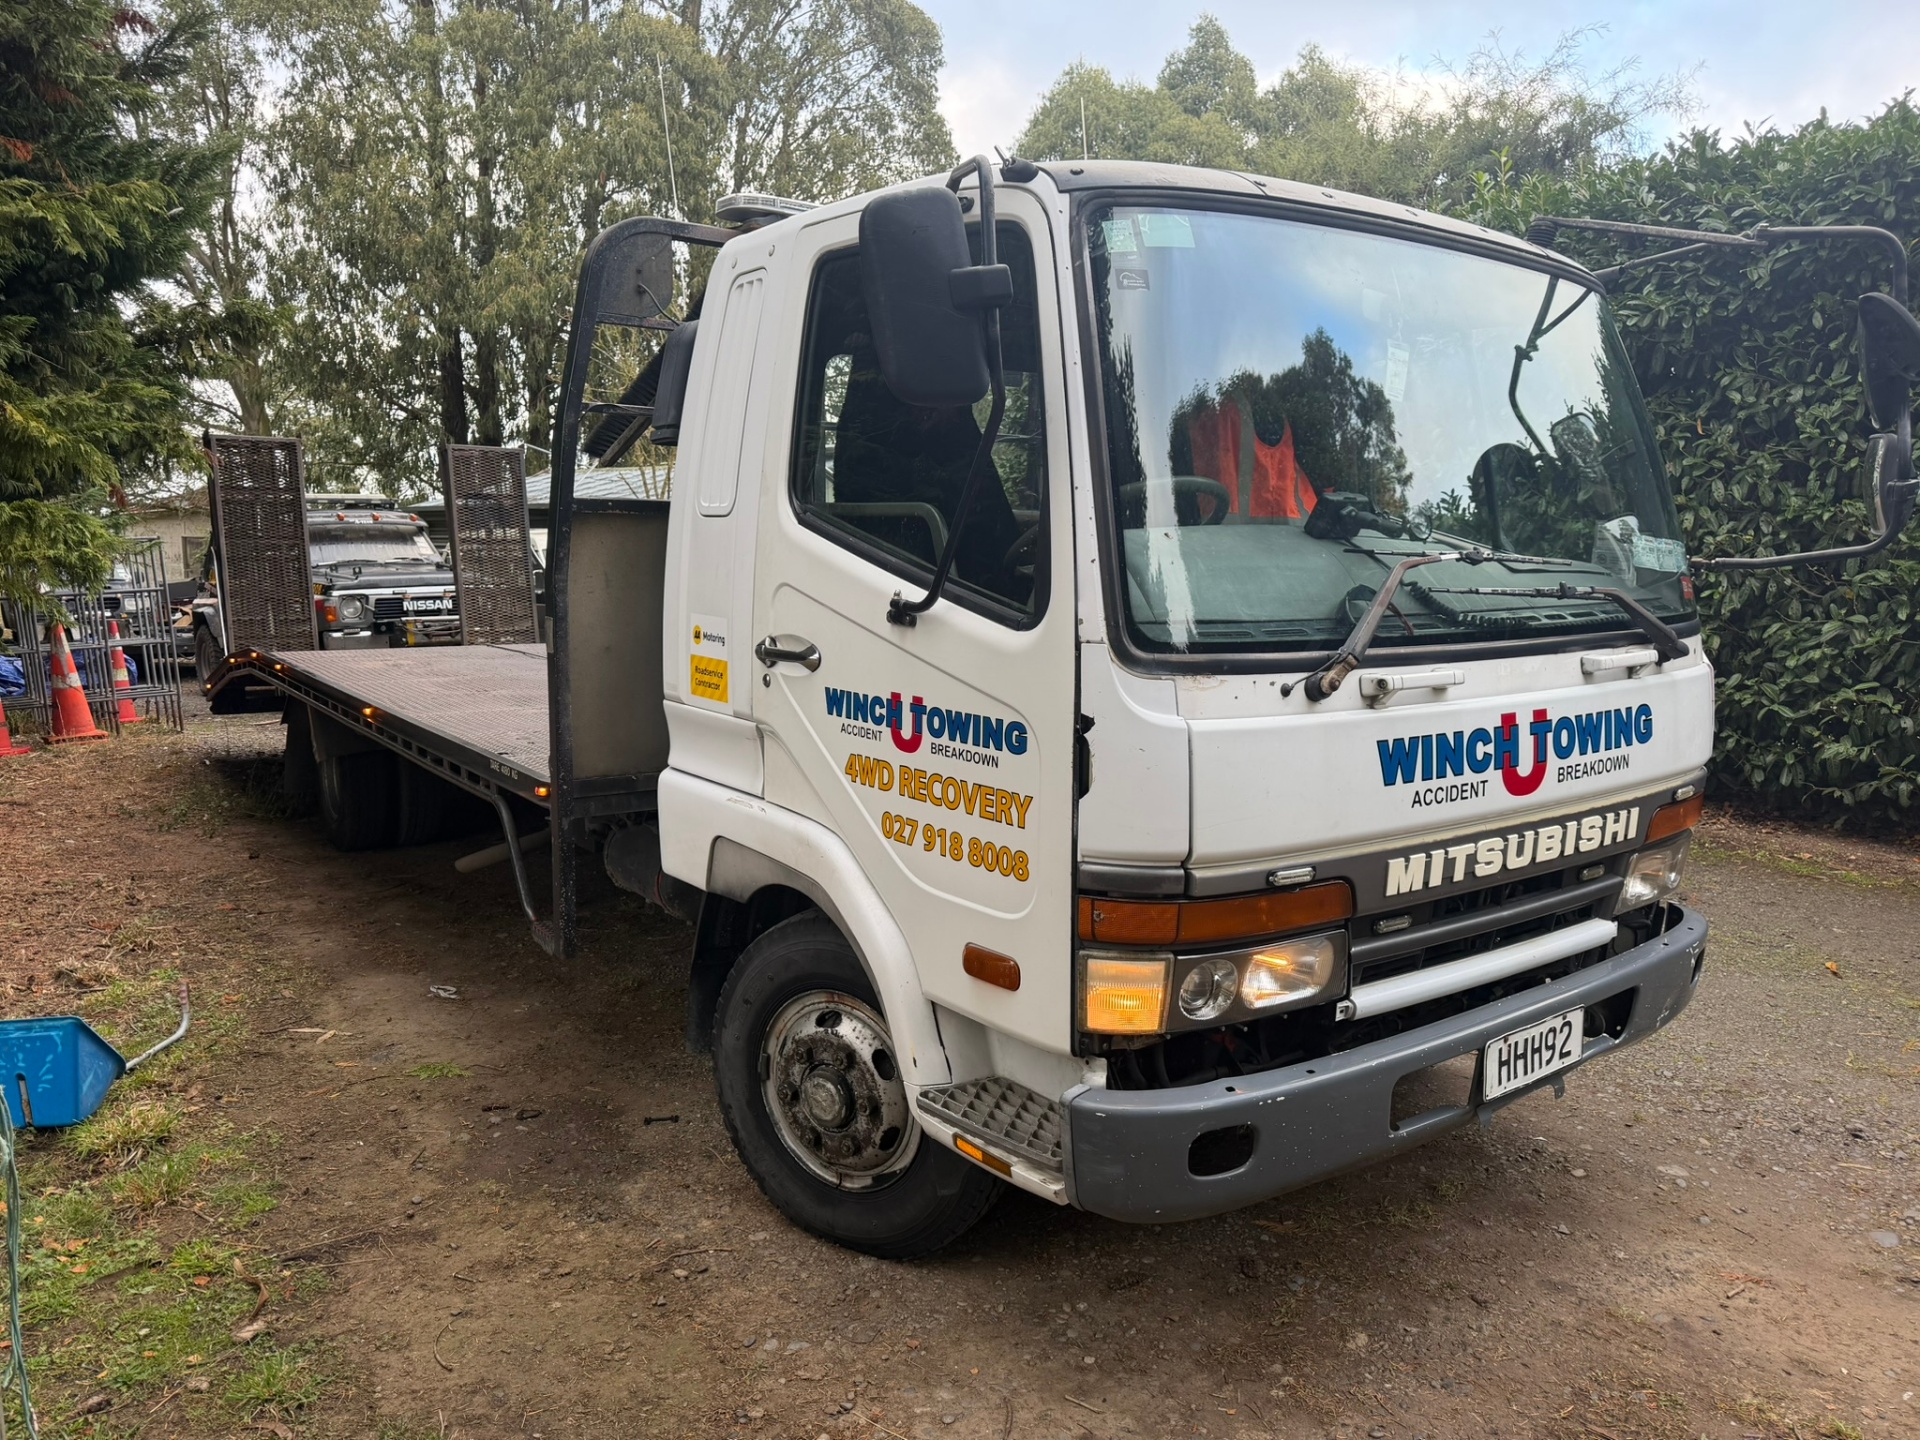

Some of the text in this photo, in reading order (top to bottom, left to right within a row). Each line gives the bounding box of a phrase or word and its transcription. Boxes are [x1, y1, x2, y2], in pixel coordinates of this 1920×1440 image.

[403, 599, 453, 611] NISSAN
[703, 631, 726, 647] Motoring
[695, 665, 724, 680] Roadservice
[695, 677, 721, 691] Contractor
[825, 687, 1028, 756] WINCH TOWING
[840, 722, 883, 743] ACCIDENT
[930, 742, 1000, 769] BREAKDOWN
[1376, 703, 1653, 787] WINCH TOWING
[1557, 753, 1630, 784] BREAKDOWN
[845, 753, 1034, 830] 4WD RECOVERY
[1411, 779, 1489, 809] ACCIDENT
[881, 811, 1030, 882] 027 918 8008
[1384, 806, 1641, 898] MITSUBISHI
[1498, 1020, 1573, 1088] HHH92
